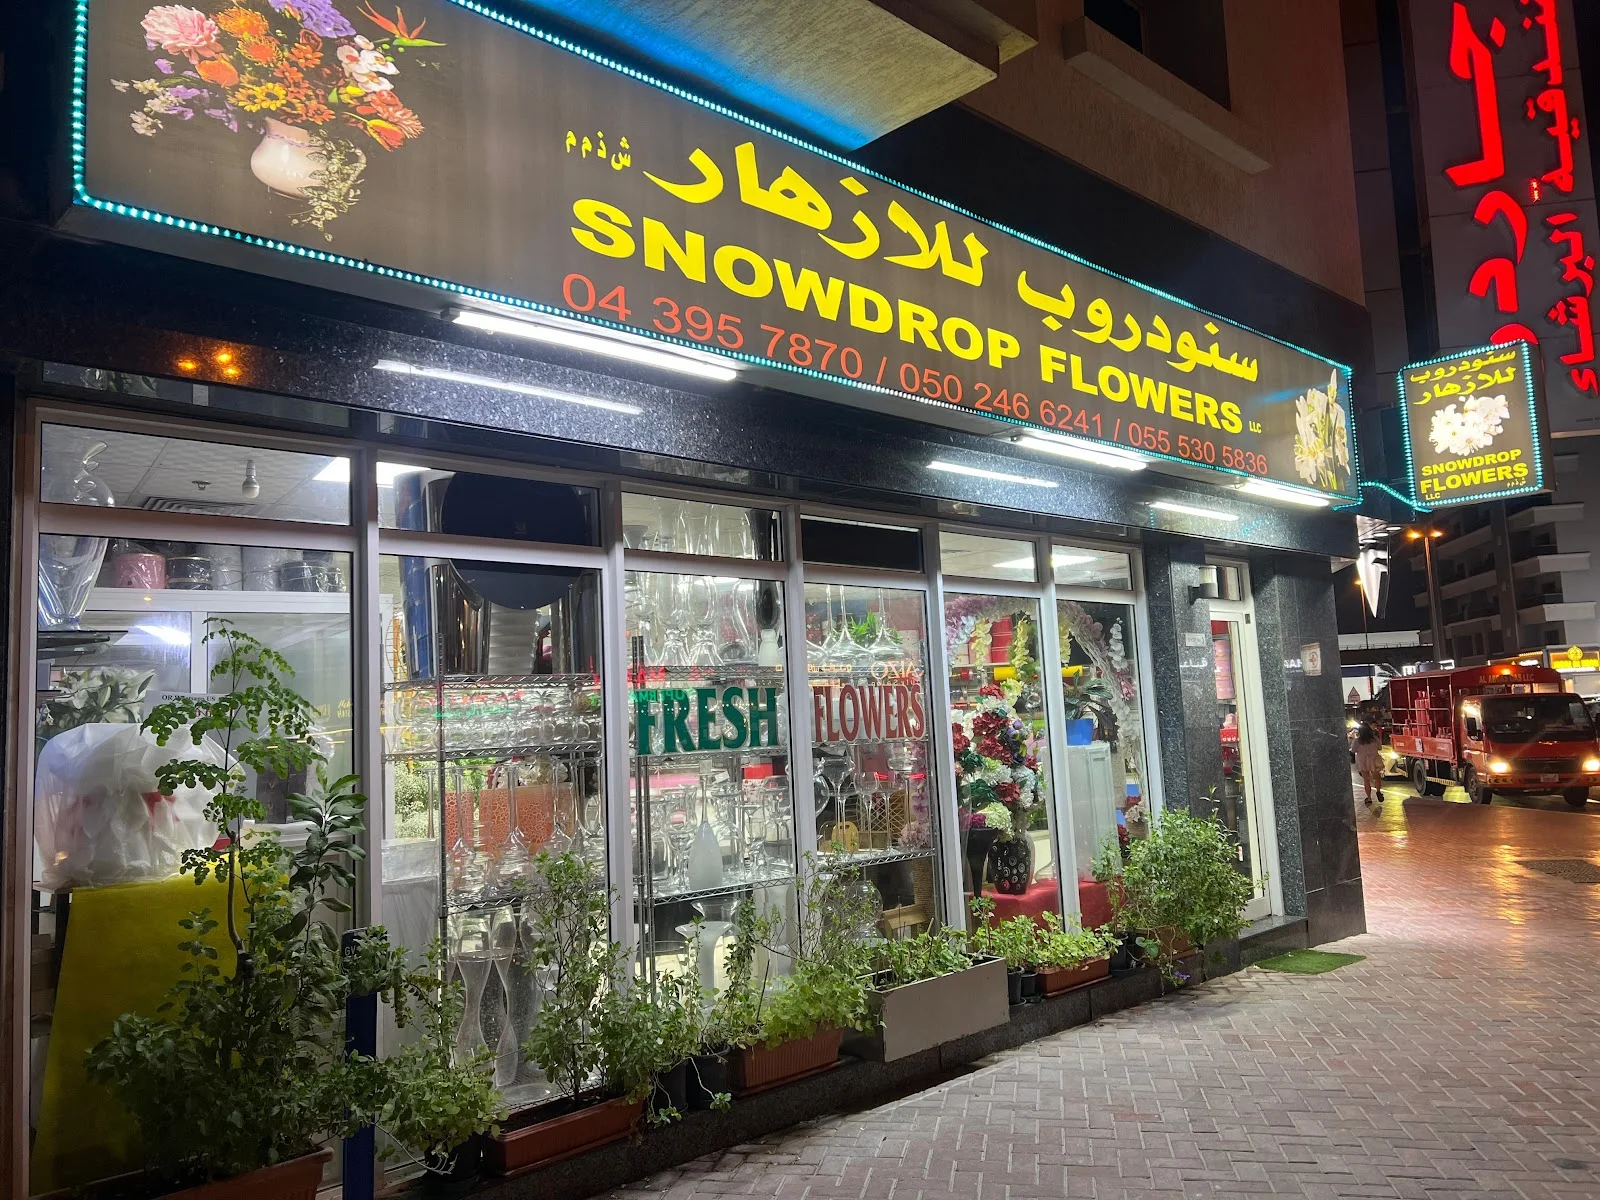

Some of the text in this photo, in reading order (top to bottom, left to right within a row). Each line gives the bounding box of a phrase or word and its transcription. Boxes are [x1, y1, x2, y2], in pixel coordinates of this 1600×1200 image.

[644, 142, 989, 287] للازهار
[571, 199, 1262, 434] SNOWDROP FLOWERS LLC
[1018, 271, 1259, 383] سنودروب
[562, 272, 633, 321] 04
[653, 297, 744, 350] 395
[760, 323, 863, 379] 7870
[899, 362, 963, 404] 050
[974, 383, 1031, 420] 246
[1039, 400, 1103, 437] 6241
[1128, 422, 1171, 453] 055
[1178, 434, 1216, 464] 530
[1223, 445, 1268, 475] 5836
[1410, 350, 1517, 384] سنودروب
[1420, 463, 1529, 494] FLOWERS
[1421, 449, 1522, 477] SNOWDROP
[1425, 491, 1441, 500] LLC
[1479, 675, 1488, 684] AL
[1523, 673, 1535, 682] LLC
[636, 686, 779, 755] FRESH
[812, 683, 926, 742] FLOWERS
